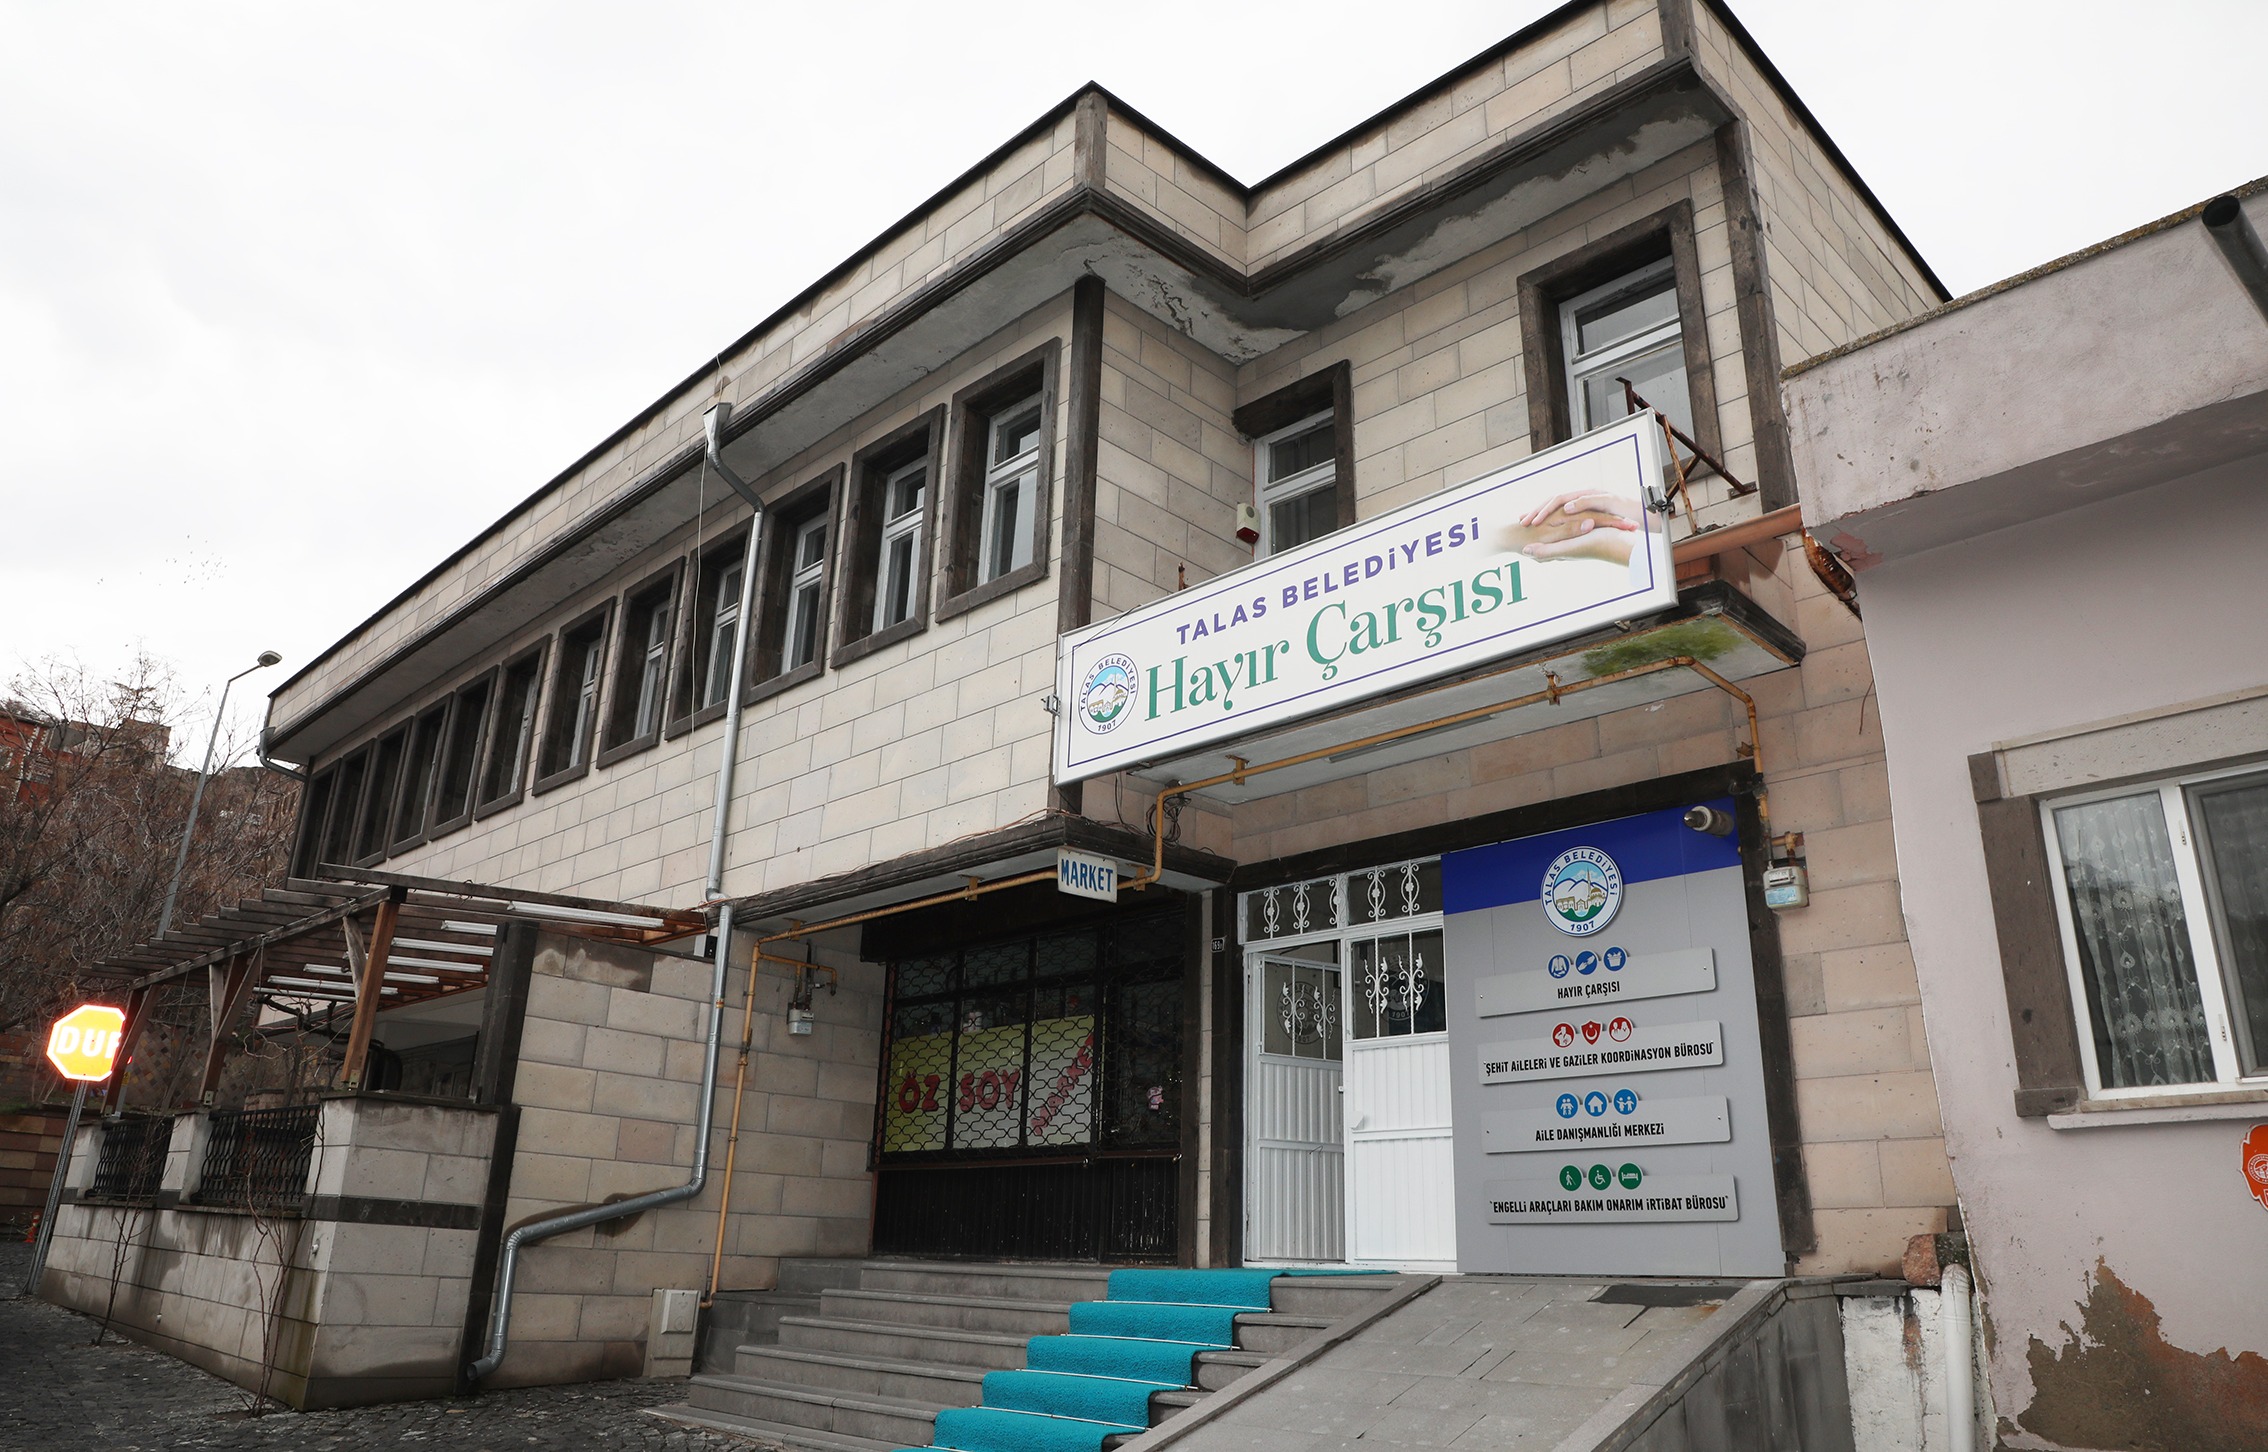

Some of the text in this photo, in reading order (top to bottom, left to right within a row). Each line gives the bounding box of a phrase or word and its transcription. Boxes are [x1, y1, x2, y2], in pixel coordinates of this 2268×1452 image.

[1176, 596, 1267, 645] TALAS
[1144, 560, 1528, 721] Hayır Çarşısı
[1080, 674, 1095, 712] TALAS
[1098, 719, 1117, 732] 1907
[1061, 858, 1113, 892] MARKET
[1544, 864, 1561, 906] TALAS
[1570, 920, 1595, 932] 1907
[1557, 981, 1620, 999] HAYIR ÇARŞISI
[1549, 1057, 1561, 1068] VE
[898, 1070, 941, 1114] ÖZ
[959, 1068, 1021, 1113] SOY
[1557, 1123, 1621, 1142] DANIŞMANLIĞI
[1529, 1200, 1572, 1215] ARAÇLARI
[1574, 1199, 1604, 1212] BAKIM
[1606, 1198, 1643, 1211] ONARIM
